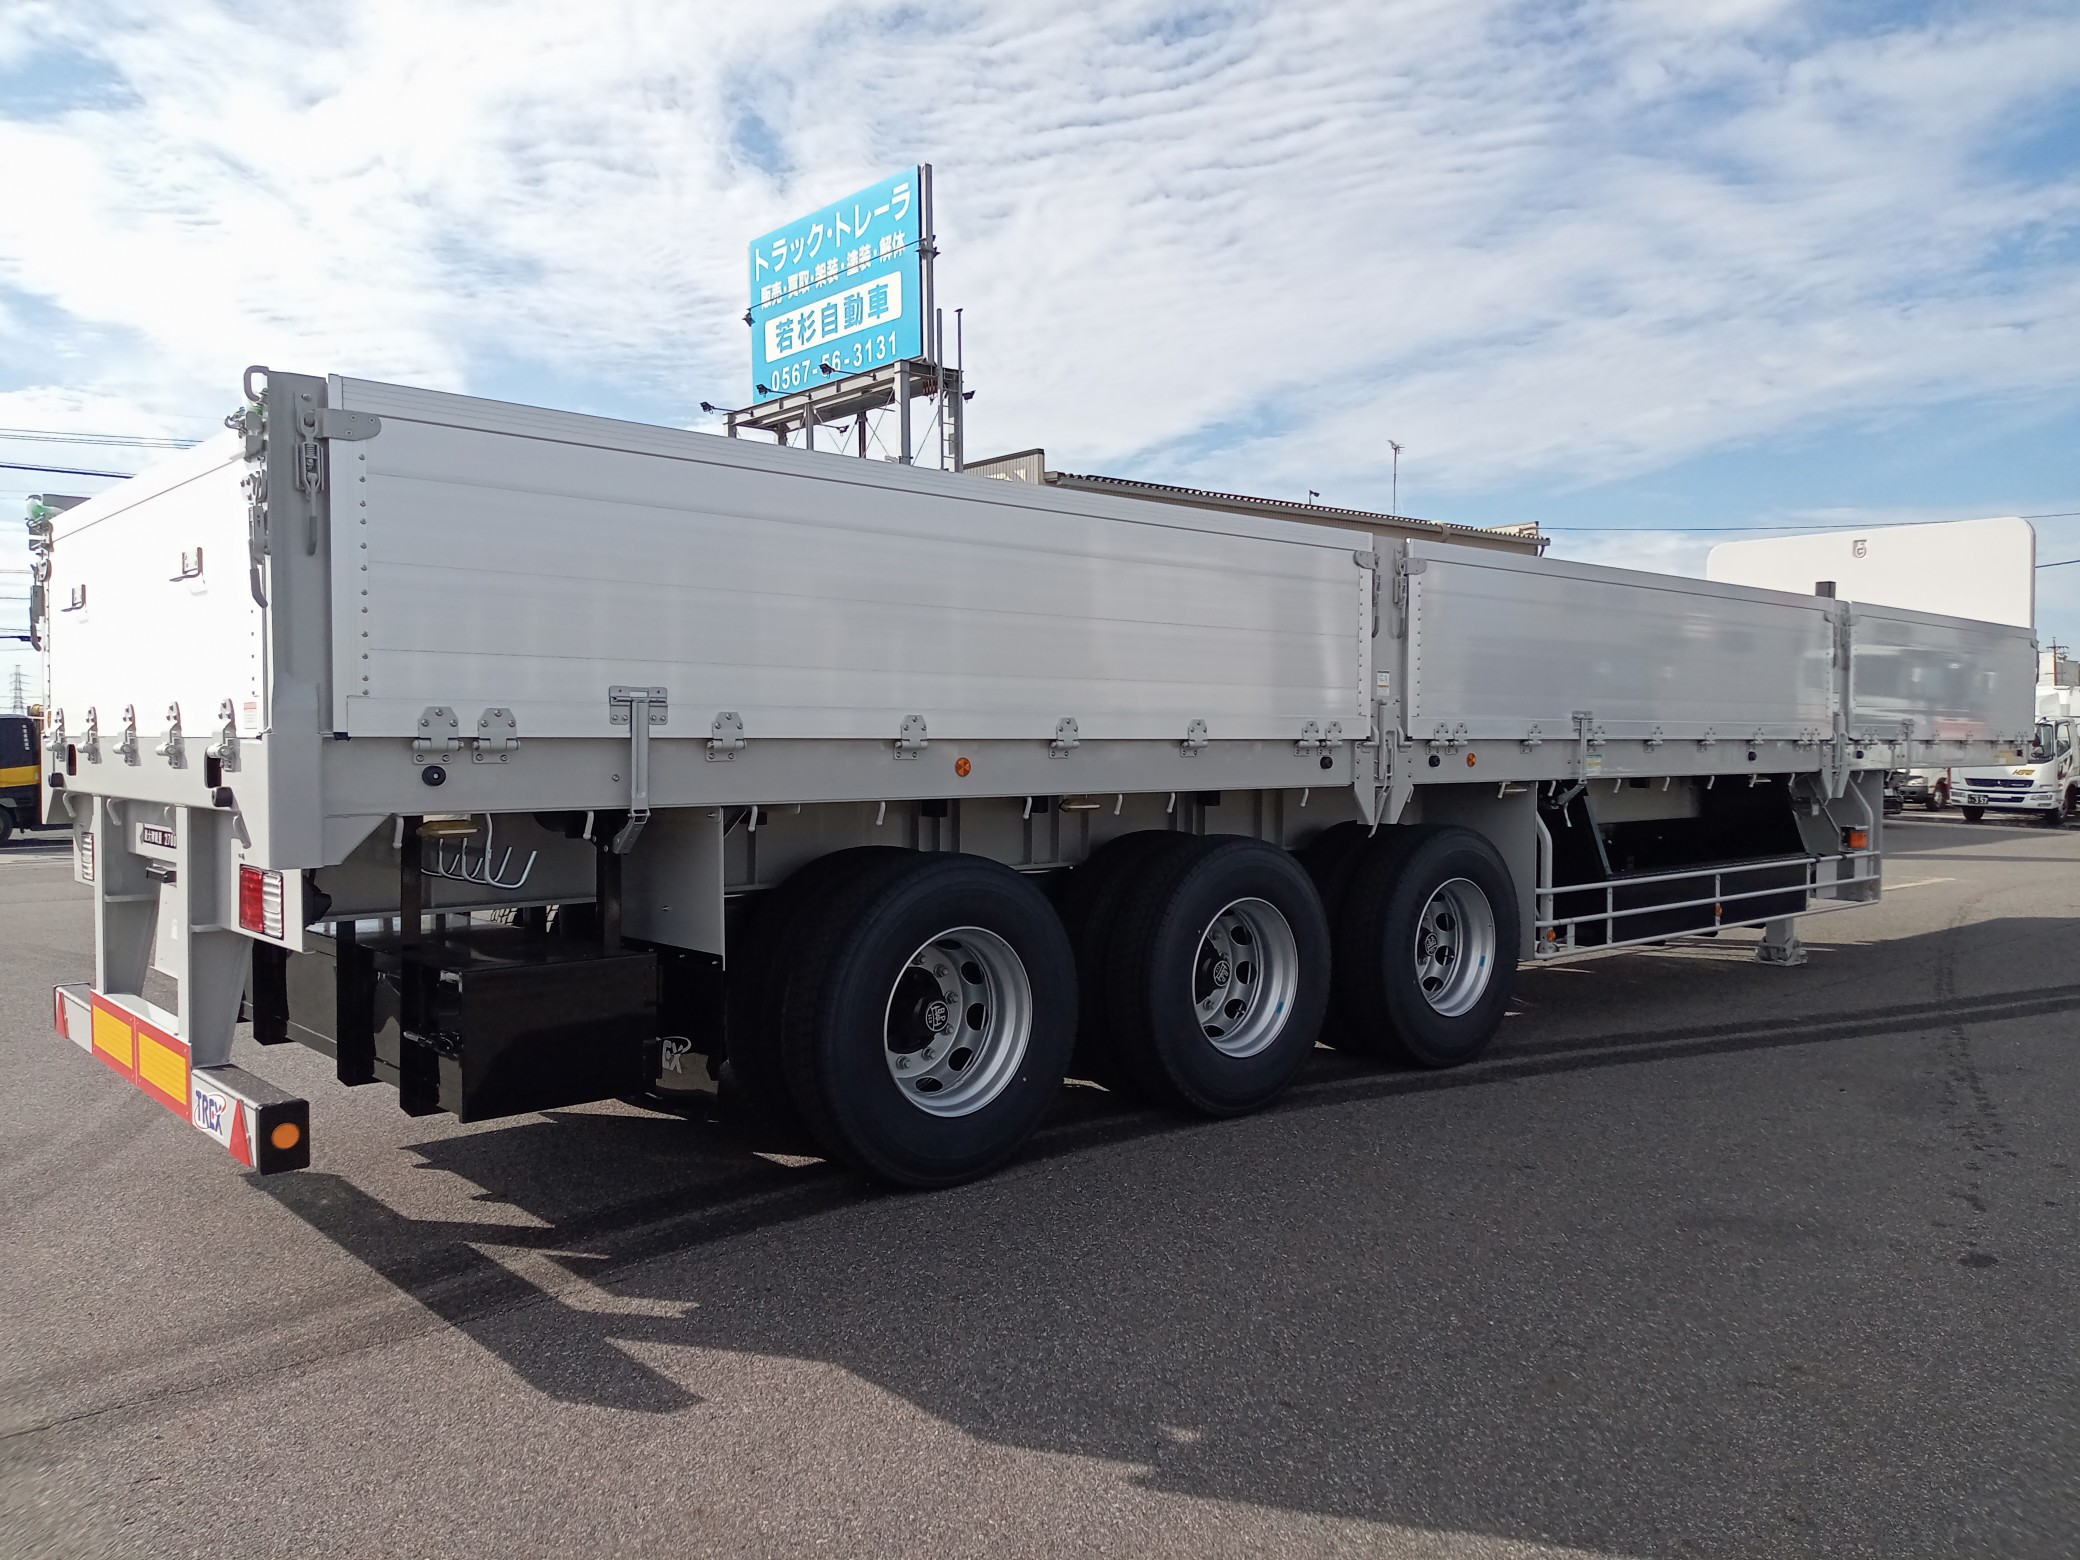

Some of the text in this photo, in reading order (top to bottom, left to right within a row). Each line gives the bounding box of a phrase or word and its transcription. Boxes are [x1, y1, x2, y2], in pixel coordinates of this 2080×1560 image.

[755, 182, 911, 281] トラック・トレーラ
[776, 284, 889, 354] 若杉自動車
[195, 1090, 223, 1136] TREX
